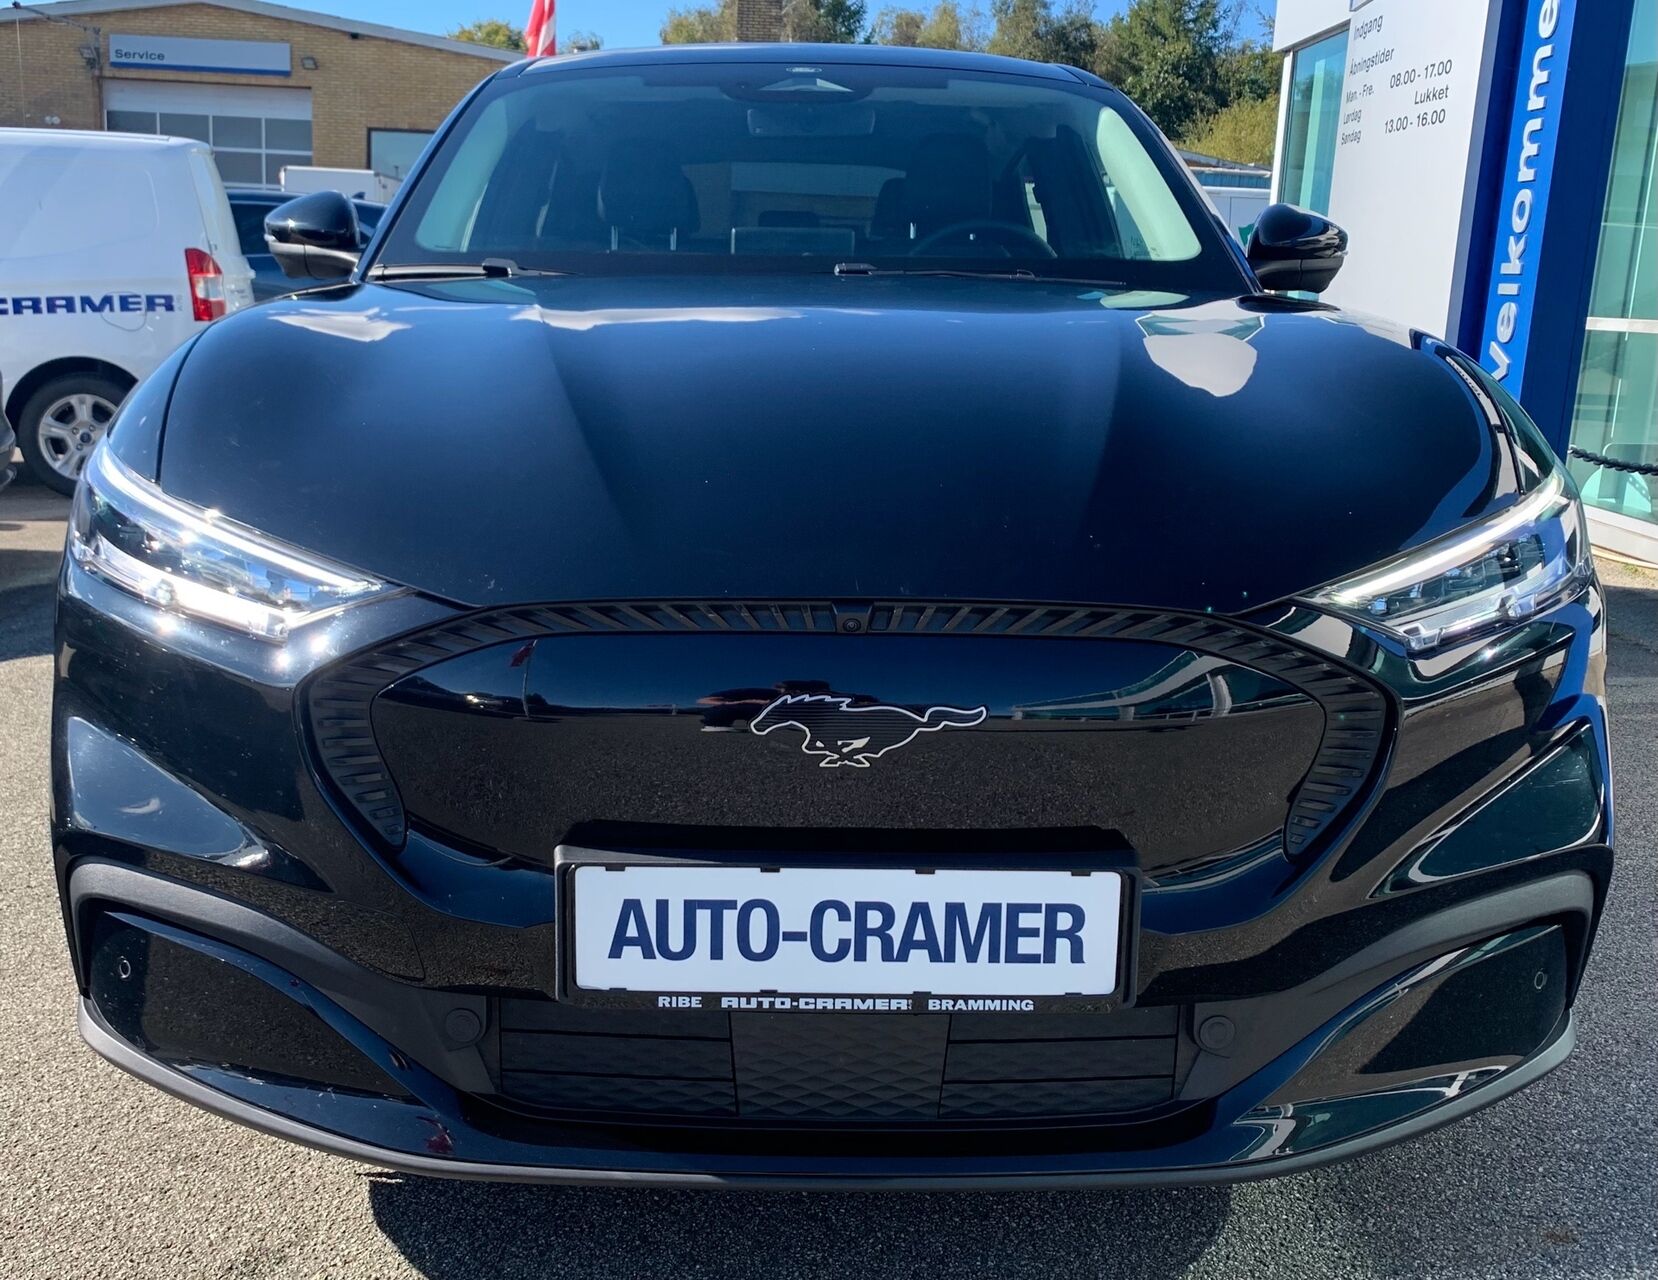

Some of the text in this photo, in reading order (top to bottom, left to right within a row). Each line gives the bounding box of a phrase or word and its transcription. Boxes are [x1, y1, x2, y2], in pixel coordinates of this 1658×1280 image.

[1353, 15, 1383, 40] Indgang
[114, 48, 165, 61] Service
[1362, 83, 1374, 98] Fre.
[1389, 68, 1416, 88] 08.00
[1424, 59, 1453, 79] 17.00
[1414, 84, 1450, 105] Lukket
[1384, 116, 1408, 134] 13.00
[1417, 108, 1446, 127] 16.00
[0, 294, 175, 315] RAMER
[607, 898, 1086, 964] AUTO-CRAMER
[658, 996, 702, 1008] RIBE
[721, 996, 908, 1010] AUTO-CRAMER
[928, 999, 1034, 1011] BRAMMING
